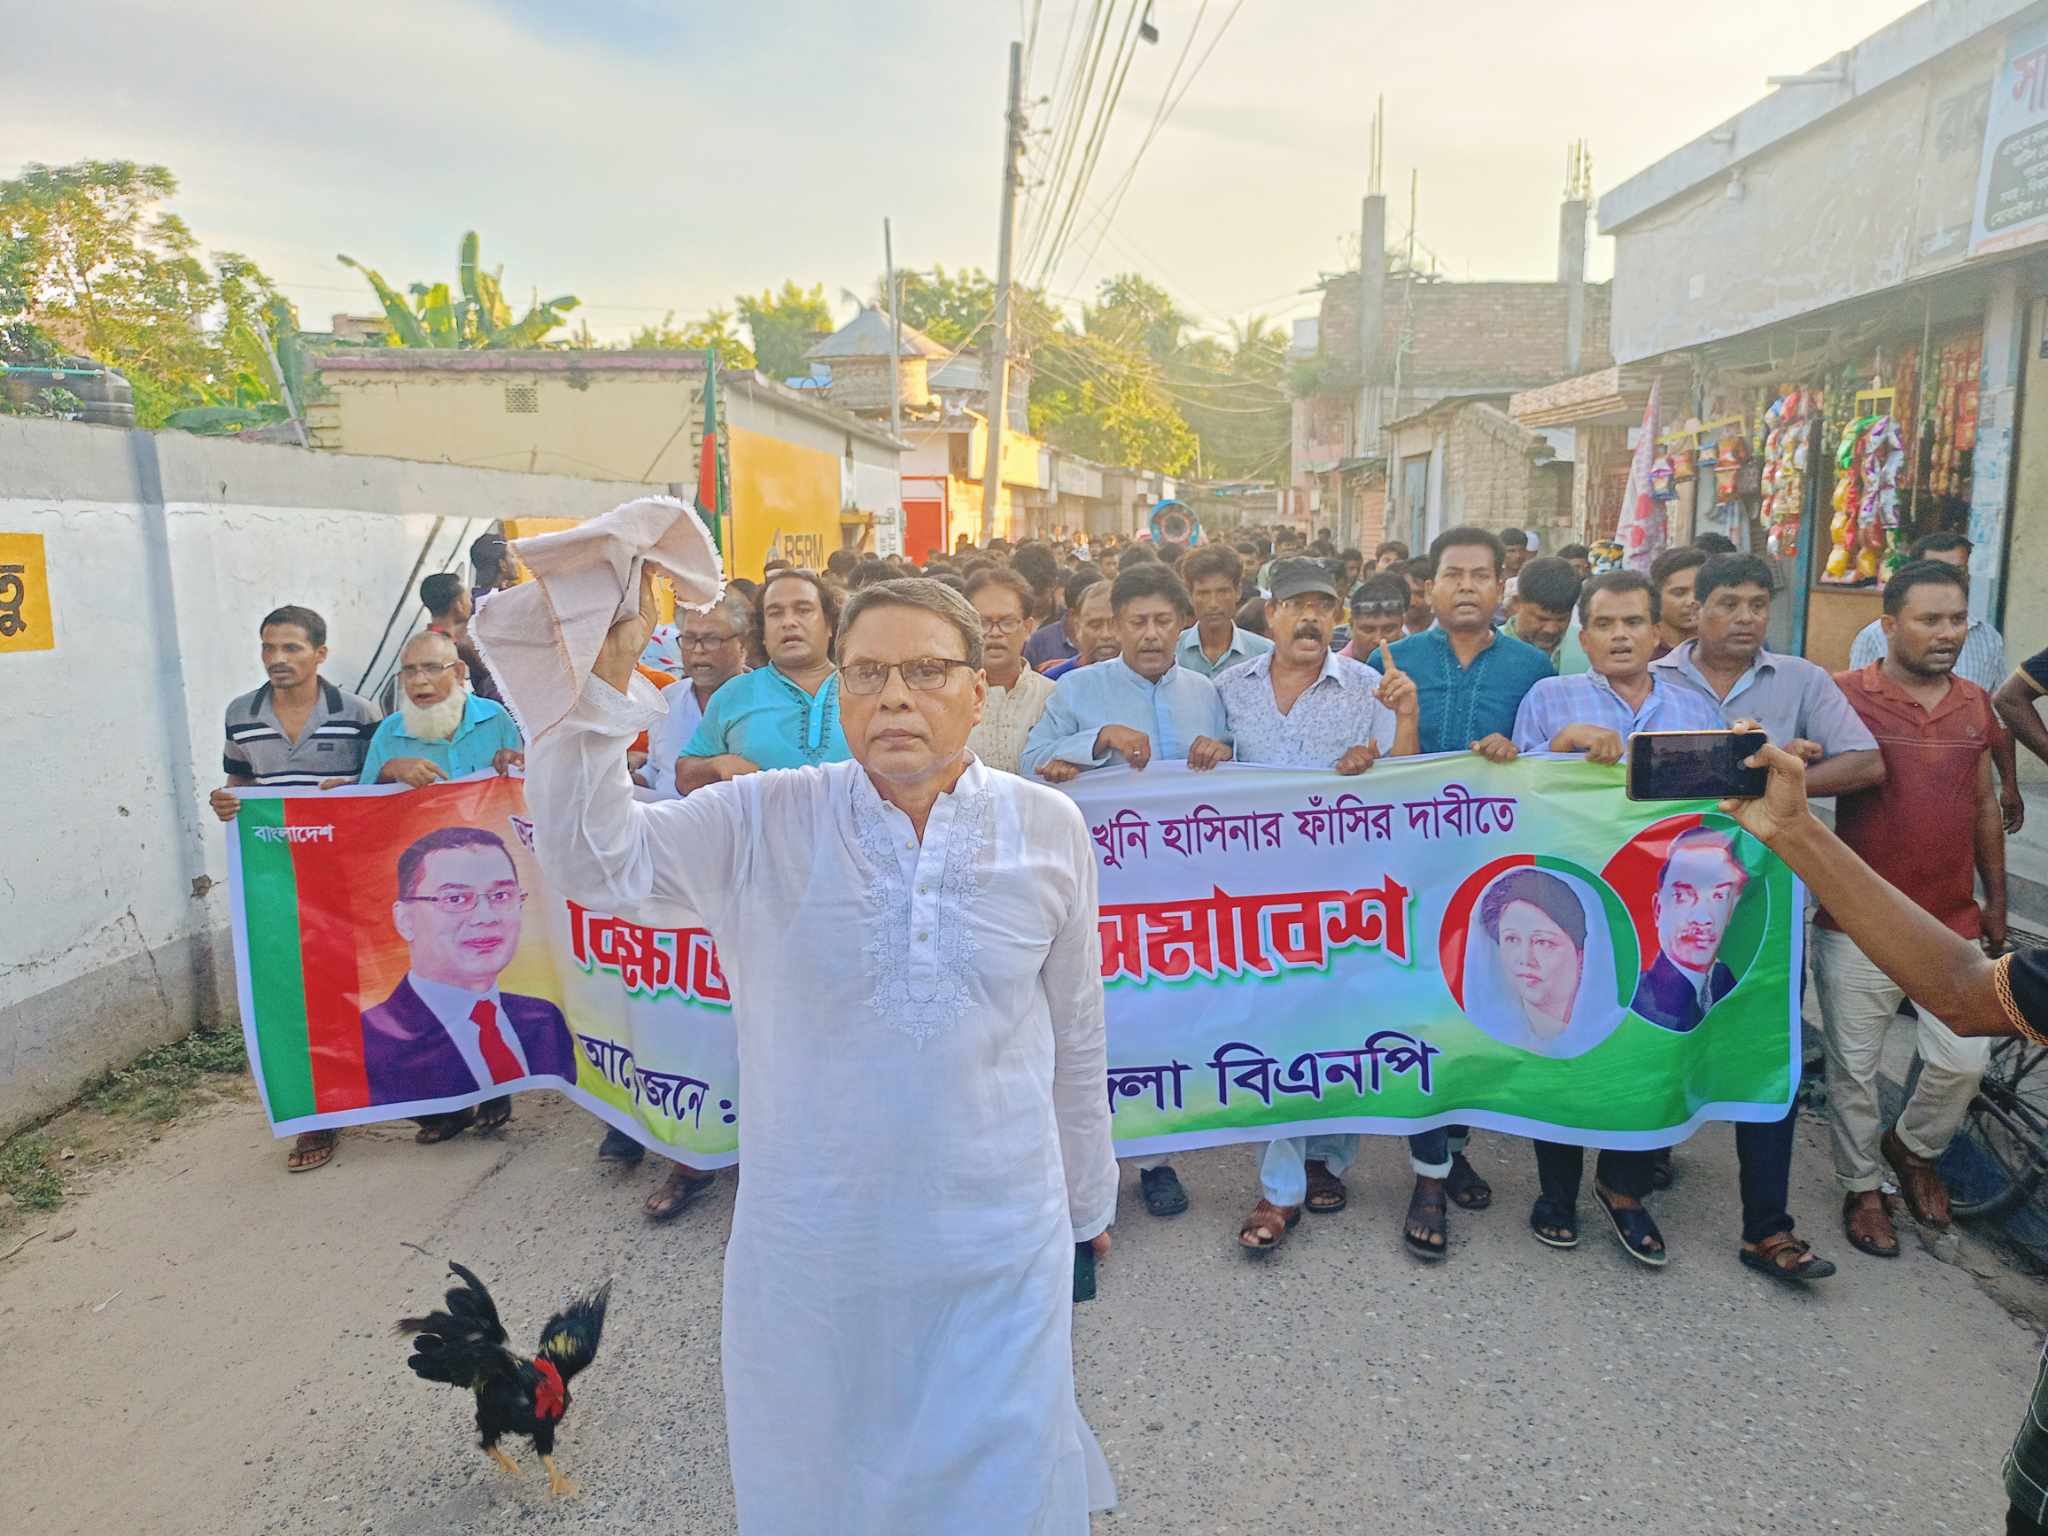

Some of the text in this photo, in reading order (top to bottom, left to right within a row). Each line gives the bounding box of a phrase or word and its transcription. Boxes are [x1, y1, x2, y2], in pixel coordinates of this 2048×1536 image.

[784, 533, 824, 569] BSRM
[251, 824, 336, 843] বাংলাদেশ
[1092, 783, 1518, 869] খুনি হাসিনার ফাঁসির দাবীতে
[1097, 873, 1408, 978] সমাবেশ
[1206, 1030, 1441, 1106] বিএনপি
